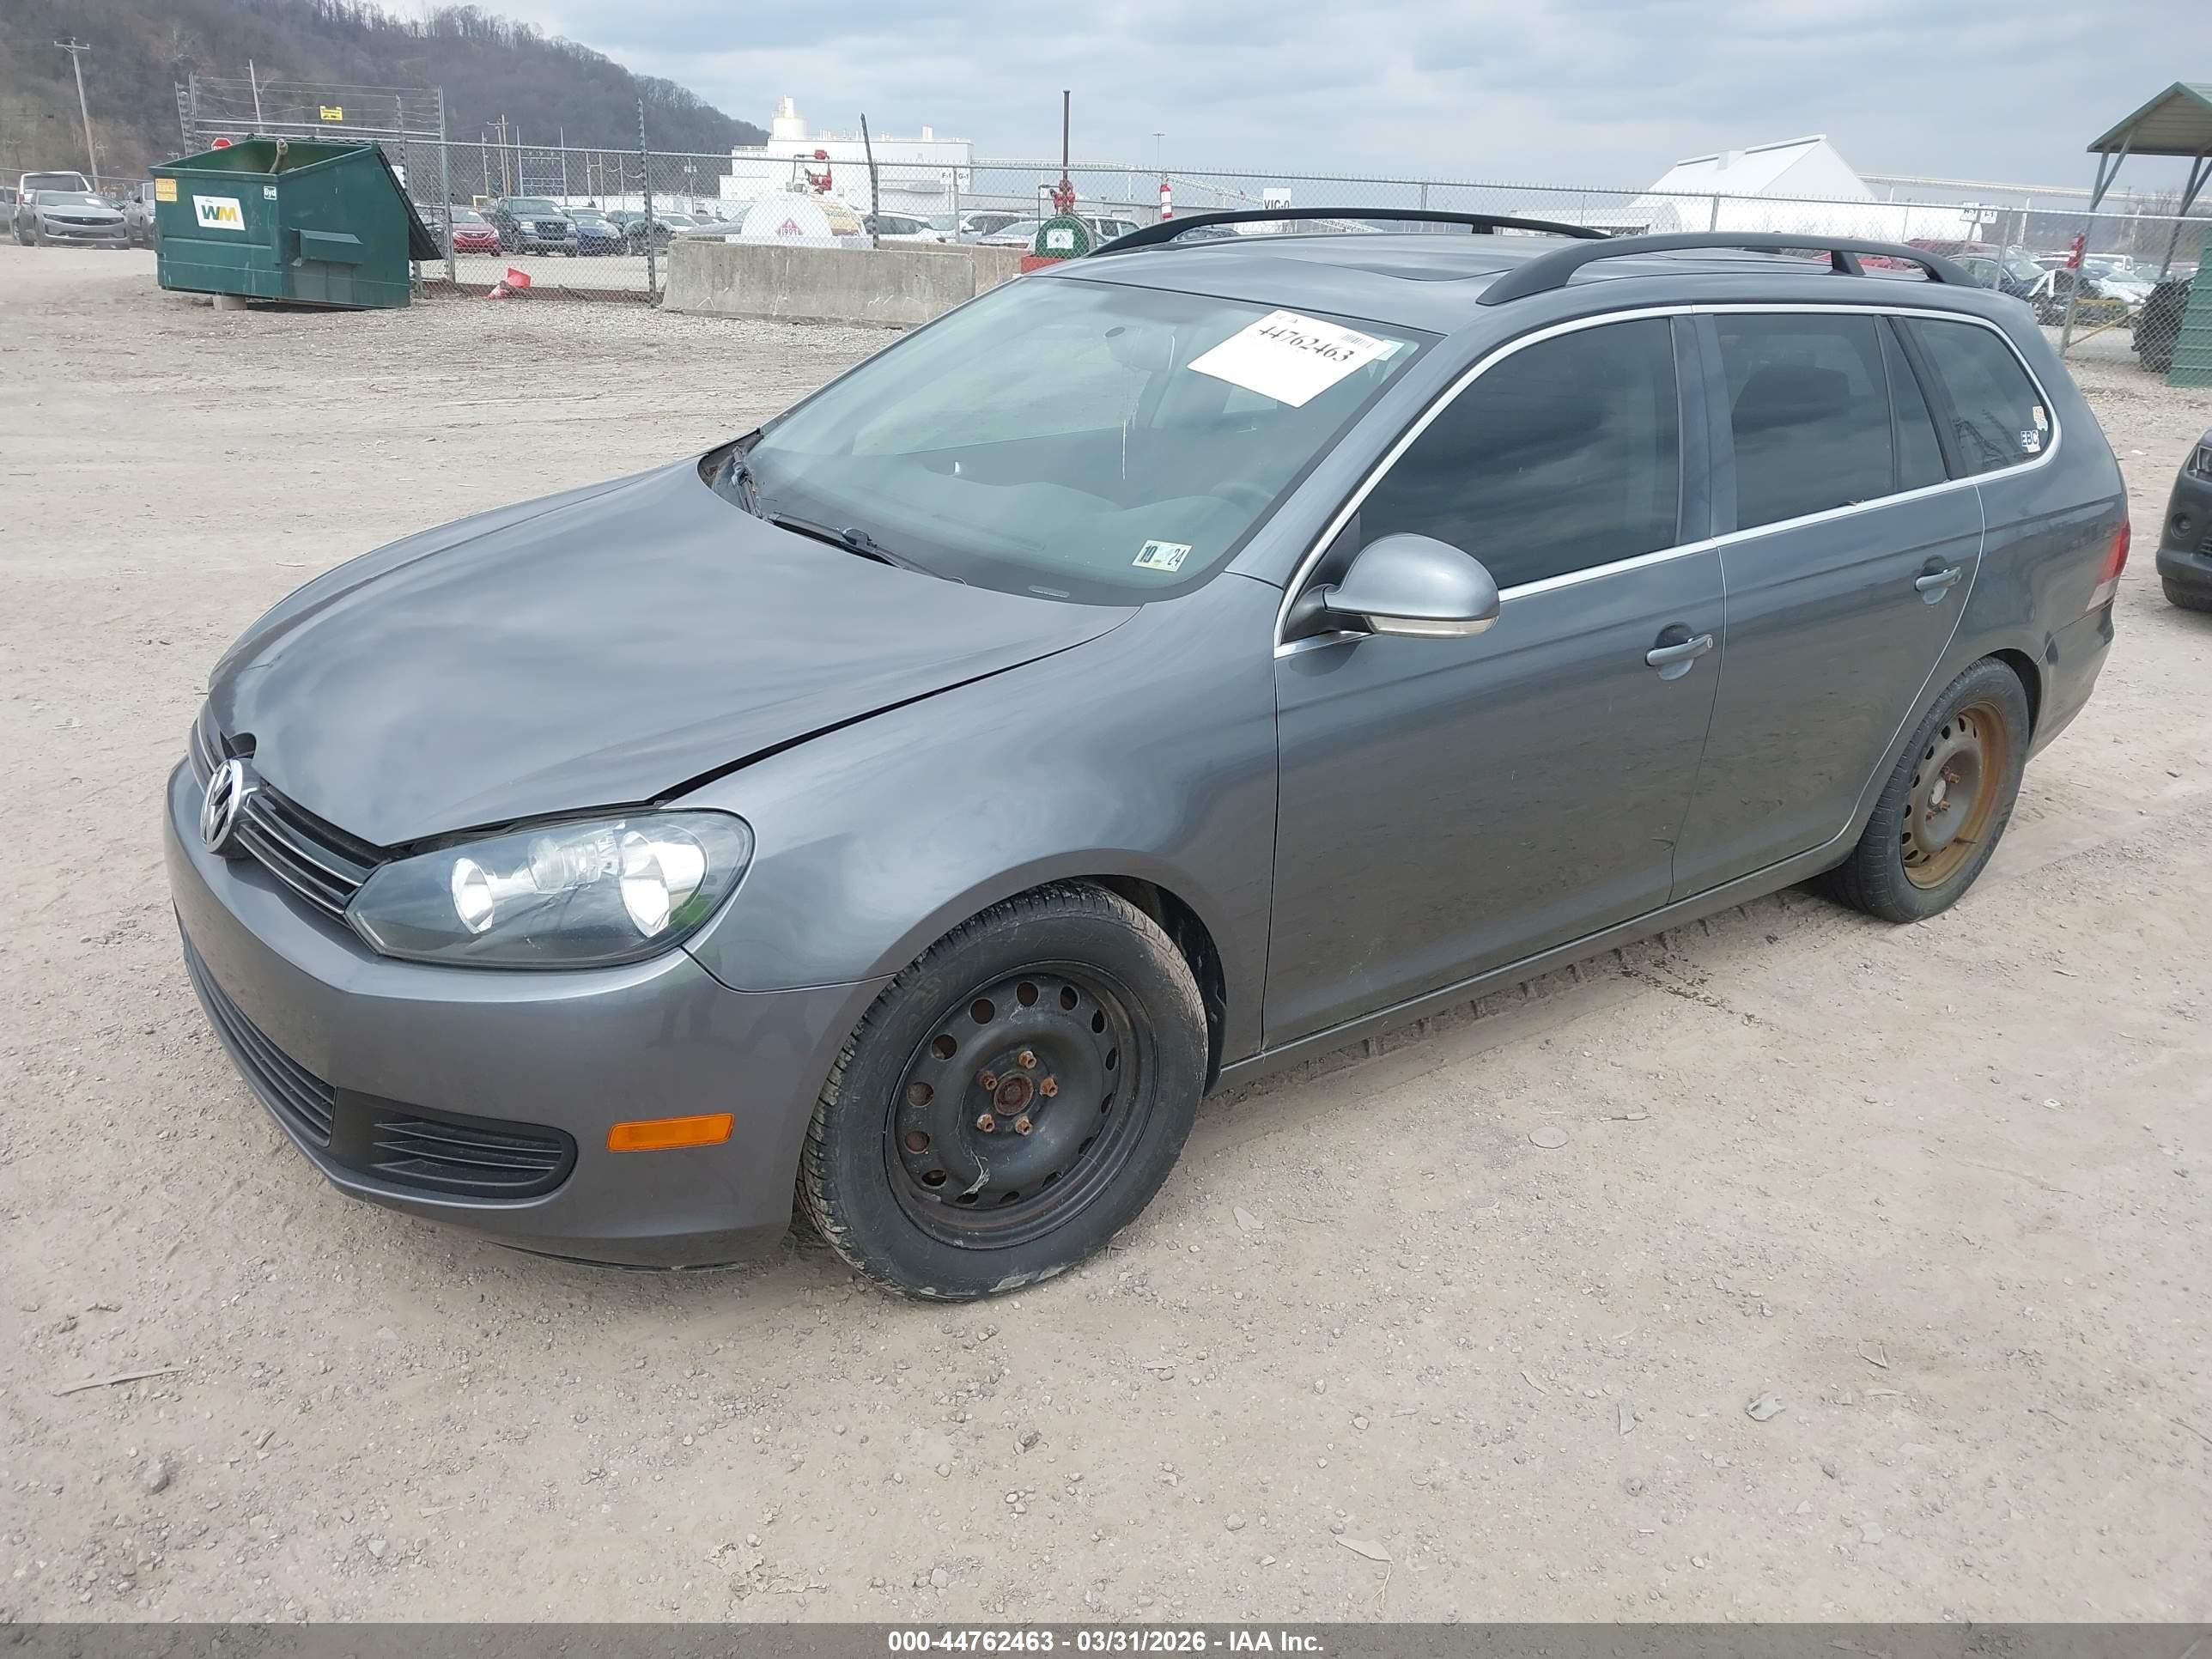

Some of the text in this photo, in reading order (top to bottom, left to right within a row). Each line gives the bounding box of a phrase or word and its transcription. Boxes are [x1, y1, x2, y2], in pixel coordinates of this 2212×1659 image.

[201, 204, 238, 222] WM
[1259, 325, 1355, 362] 44762463
[2021, 430, 2039, 445] EBC
[1139, 544, 1187, 567] 10 24
